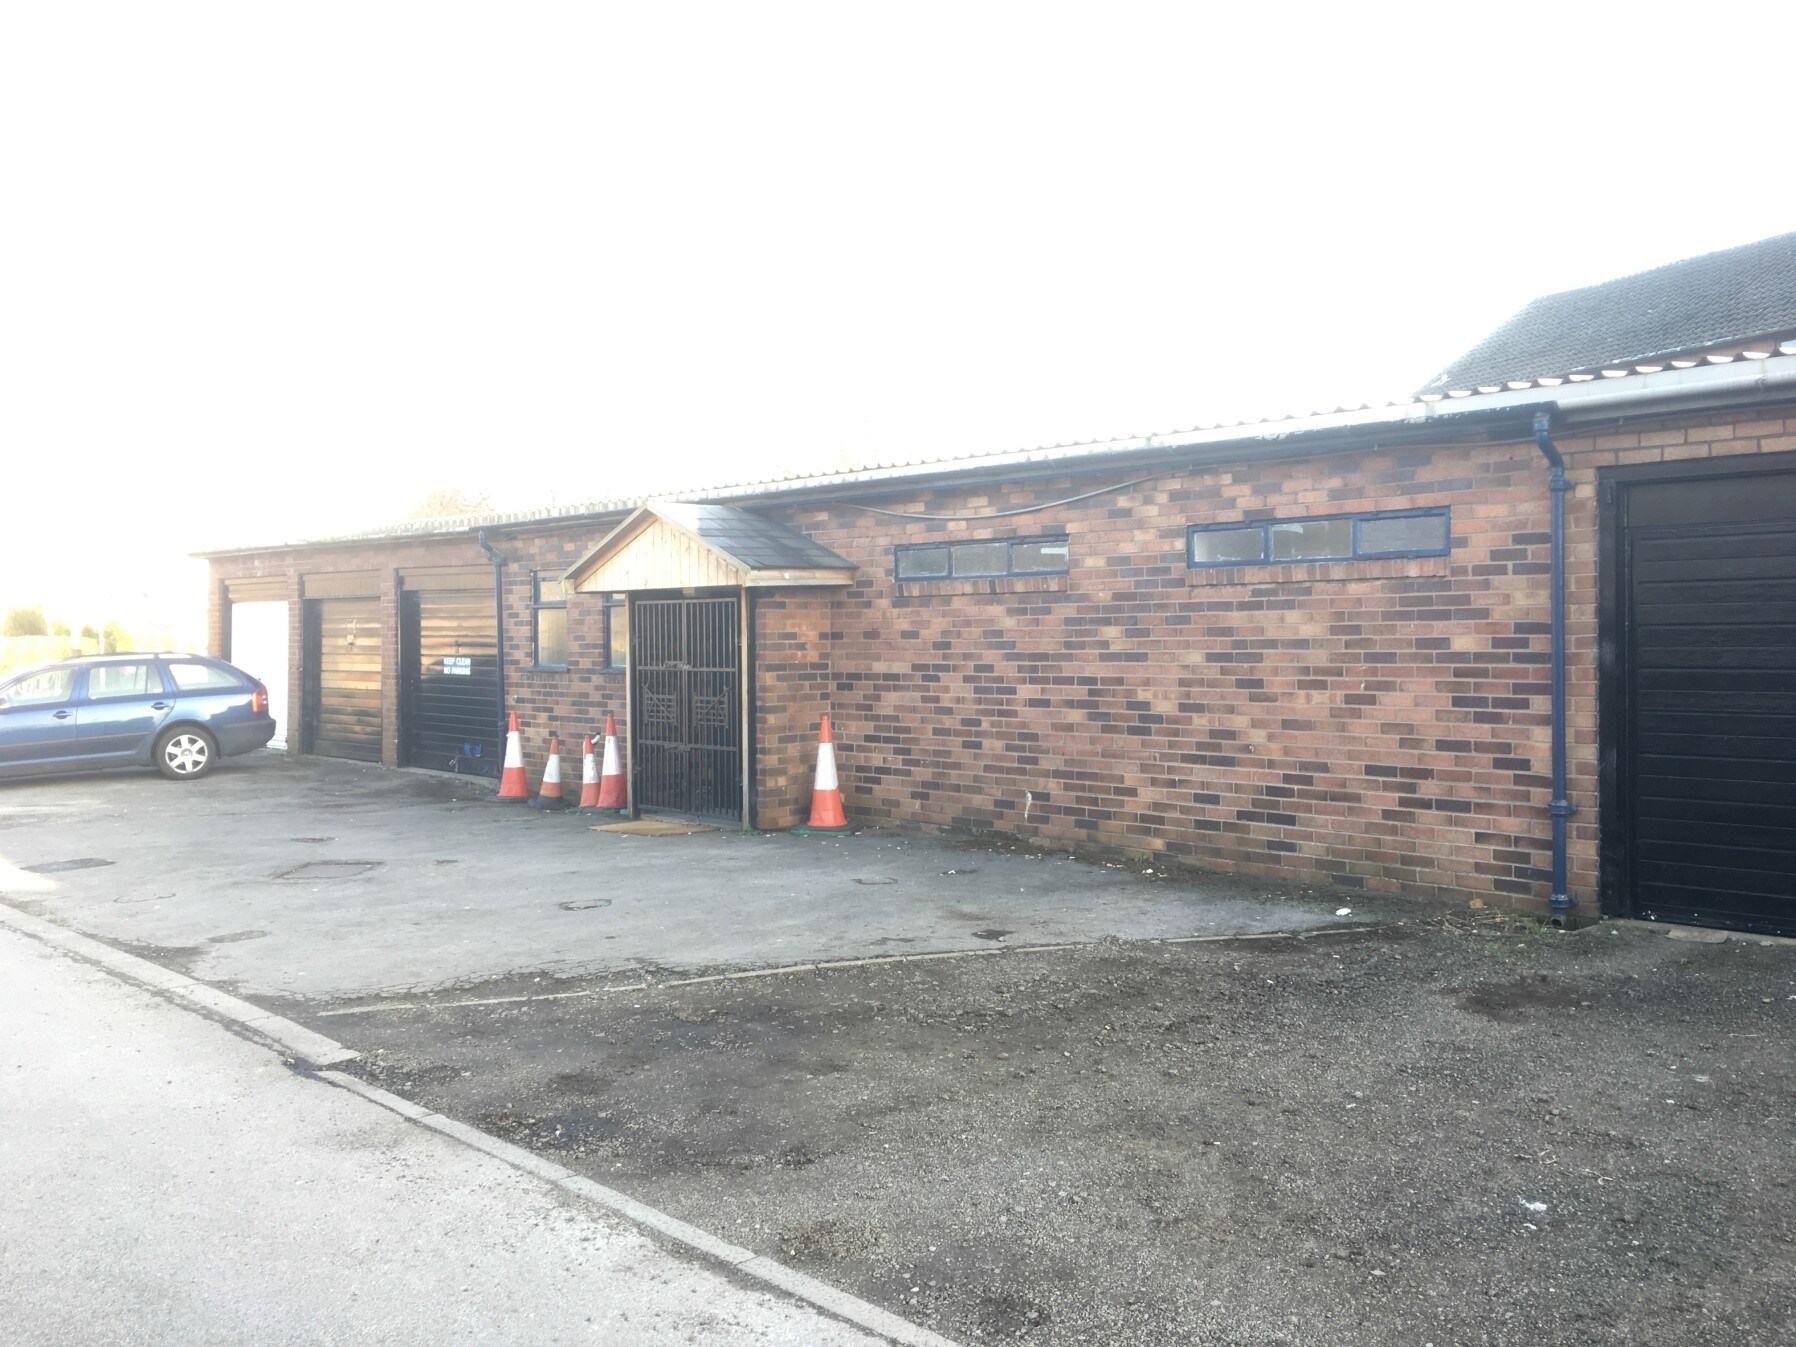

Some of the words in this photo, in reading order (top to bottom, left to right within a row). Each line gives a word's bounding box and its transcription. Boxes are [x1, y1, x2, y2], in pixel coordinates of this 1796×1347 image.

[456, 657, 471, 665] CLEAR
[443, 666, 451, 674] NO
[452, 666, 471, 675] PARKING
